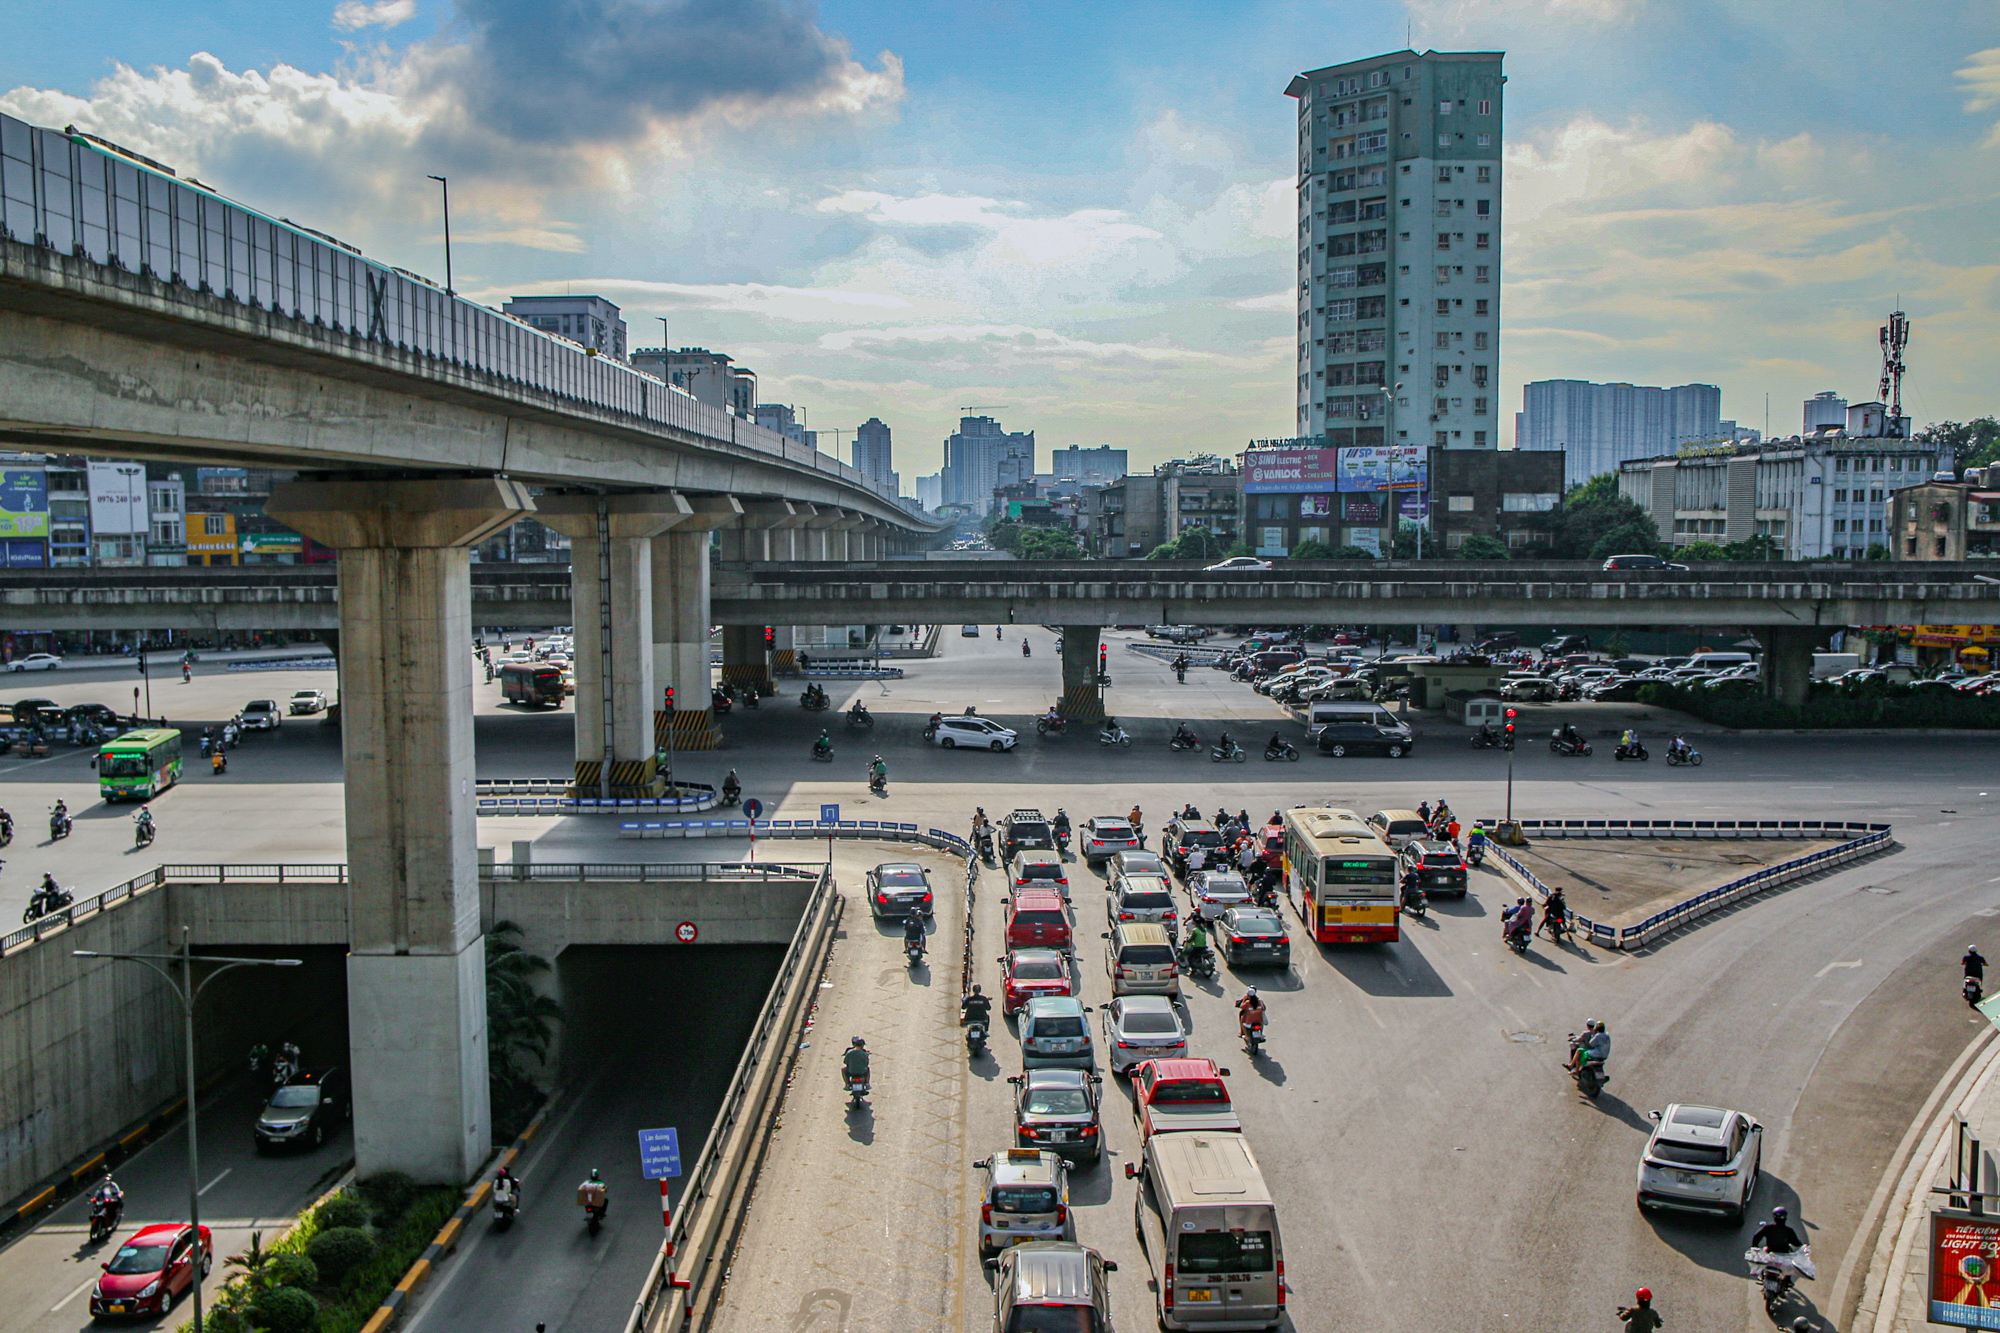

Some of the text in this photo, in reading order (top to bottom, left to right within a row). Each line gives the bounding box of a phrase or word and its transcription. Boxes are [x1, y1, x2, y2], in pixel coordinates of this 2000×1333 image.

[1359, 448, 1372, 457] SP
[1258, 455, 1301, 465] SINO ELECTRIC
[1955, 1225, 1999, 1235] TIẾT KIỆM
[1940, 1239, 1979, 1249] LIGHT
